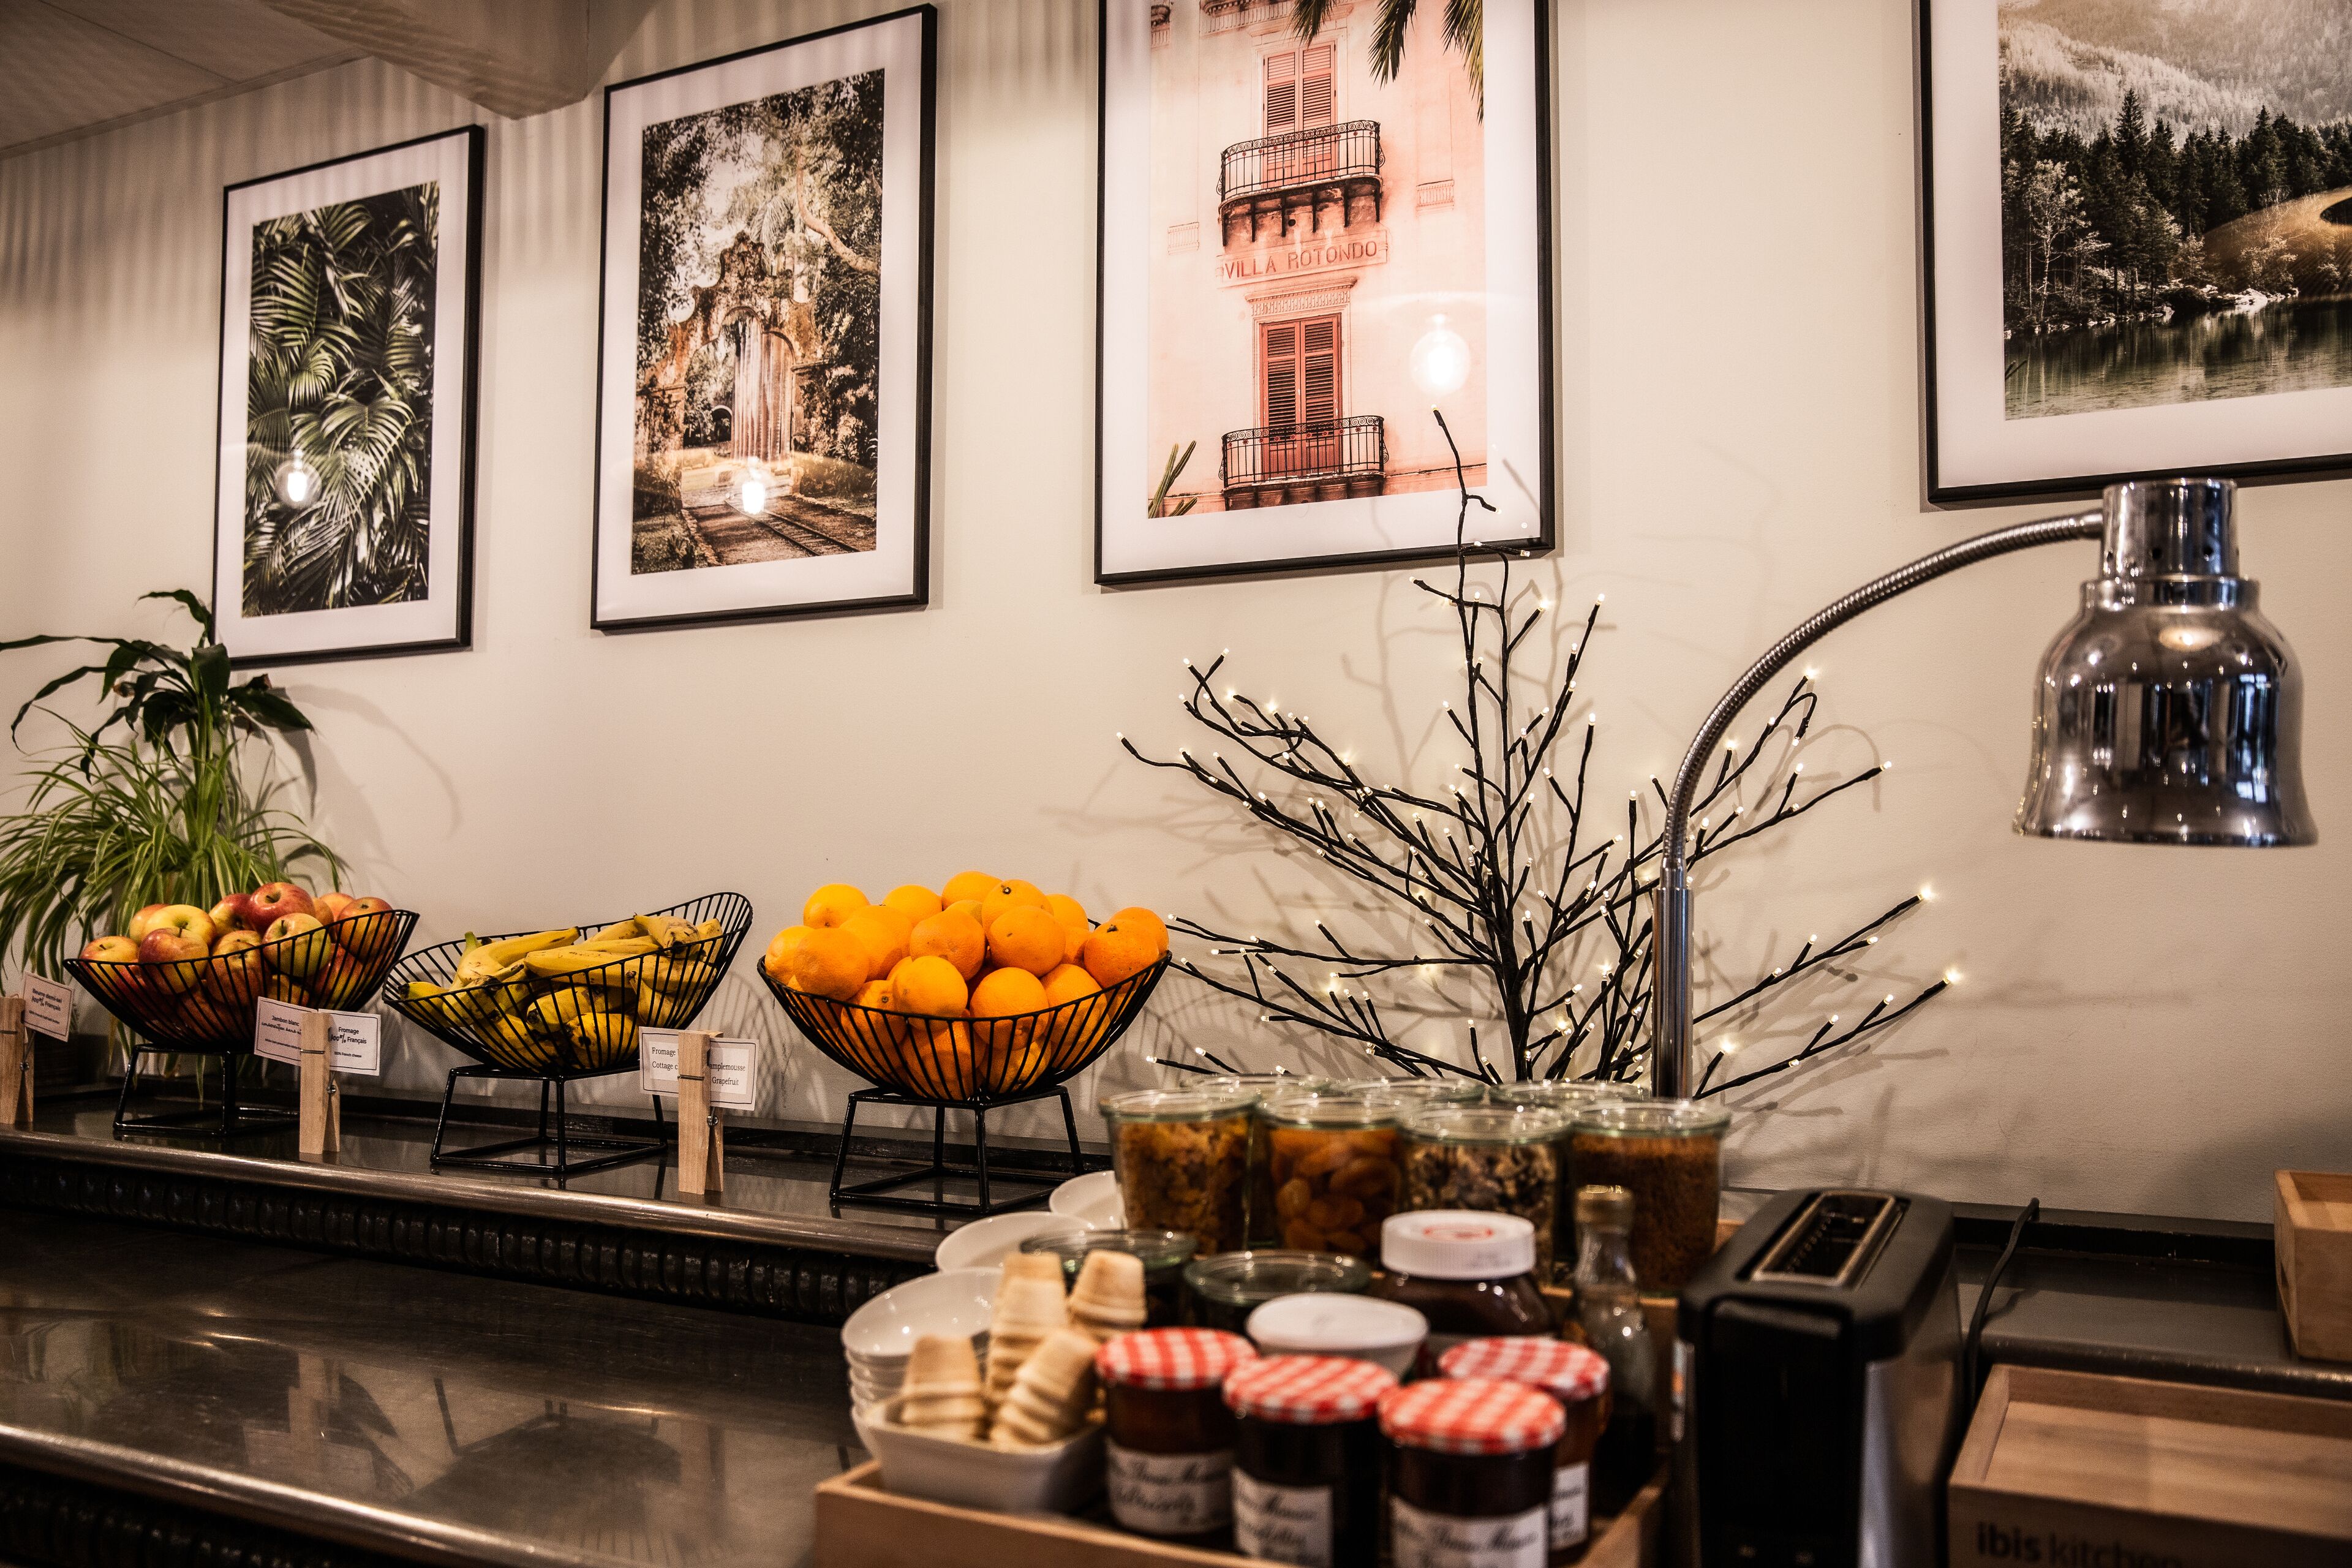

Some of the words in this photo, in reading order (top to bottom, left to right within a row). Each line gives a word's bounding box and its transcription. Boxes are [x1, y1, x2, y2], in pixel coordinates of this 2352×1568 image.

[1225, 255, 1276, 279] VILLA
[1288, 241, 1378, 270] ROTONDO
[272, 1015, 288, 1023] Jambon
[338, 1027, 360, 1035] Fromage
[331, 1033, 347, 1044] 100%
[652, 1047, 676, 1058] Fromage
[652, 1061, 673, 1071] Cottage
[709, 1062, 746, 1072] amplemousse
[712, 1076, 739, 1087] Grapefruit
[1977, 1521, 2041, 1564] ibis
